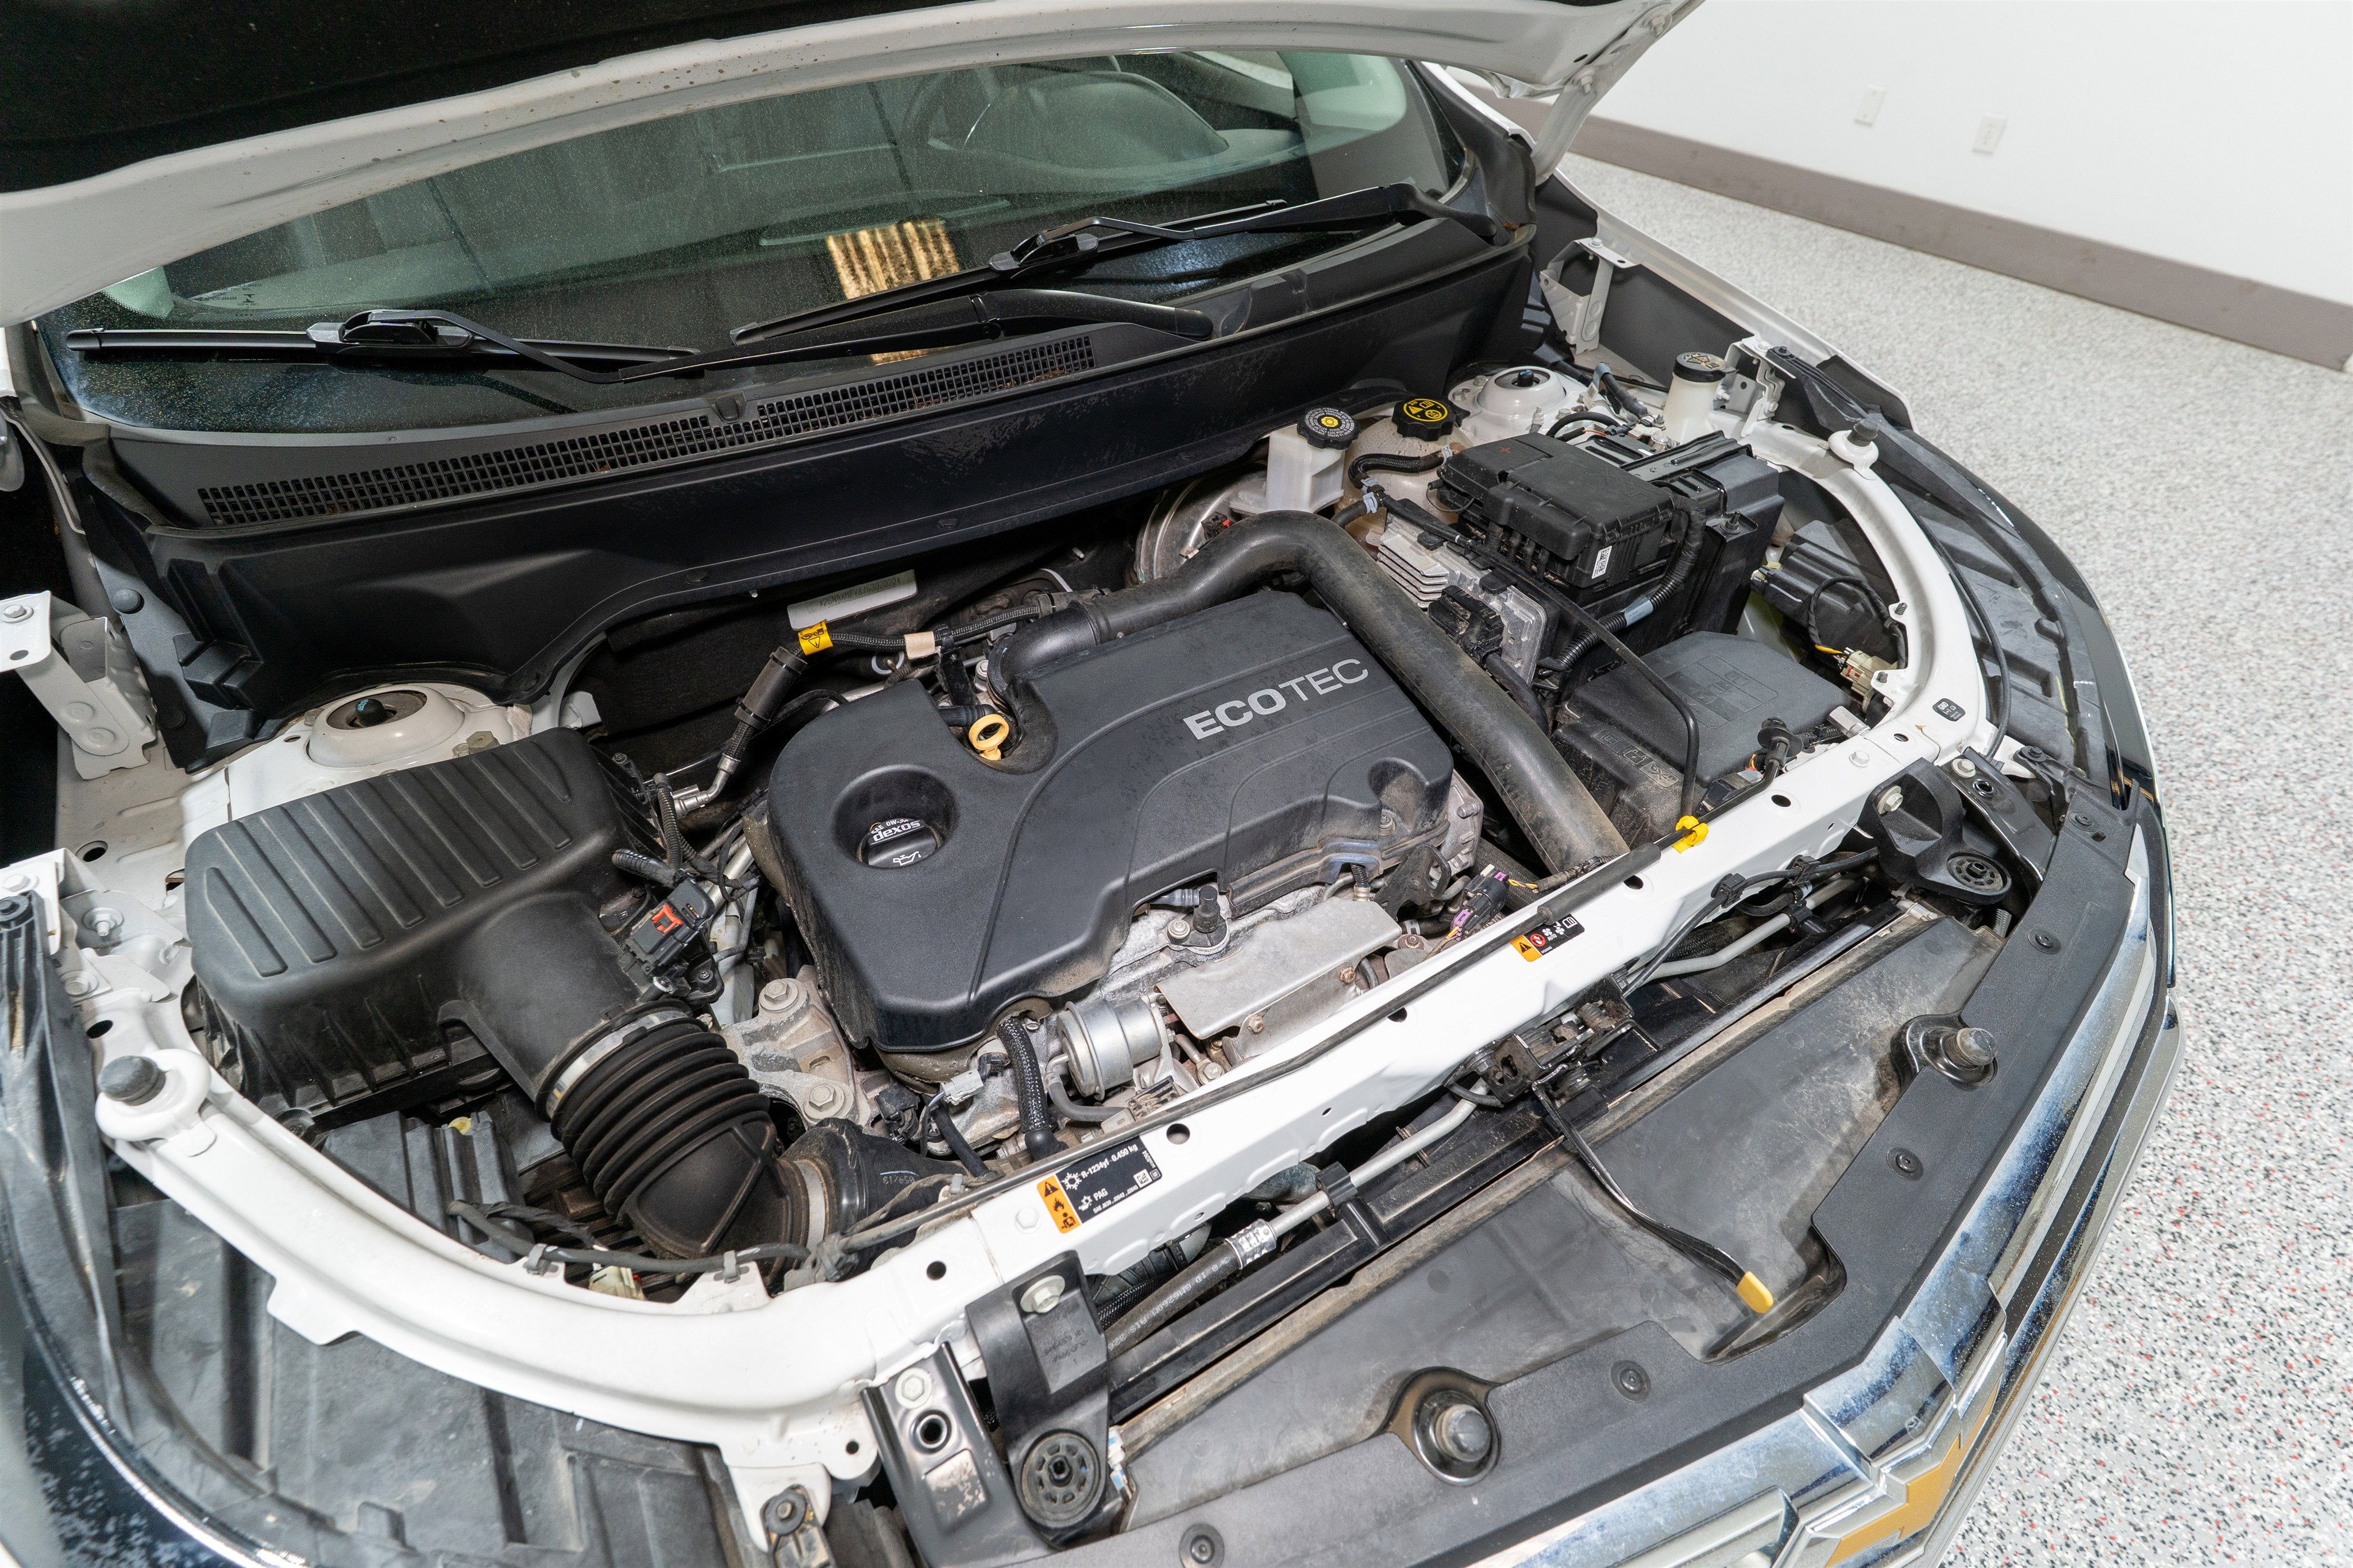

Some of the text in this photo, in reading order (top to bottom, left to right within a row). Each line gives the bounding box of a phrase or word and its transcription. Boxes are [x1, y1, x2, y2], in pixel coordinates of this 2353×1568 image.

[1183, 659, 1368, 740] ECOTEC
[871, 824, 884, 835] SAE
[873, 820, 920, 841] dexos
[1547, 933, 1557, 941] AUTO
[1081, 1144, 1138, 1179] R-1234yf 0.450 kg
[1093, 1188, 1108, 1201] PAG
[1212, 1256, 1230, 1272] 3/8
[1195, 1272, 1207, 1284] ID
